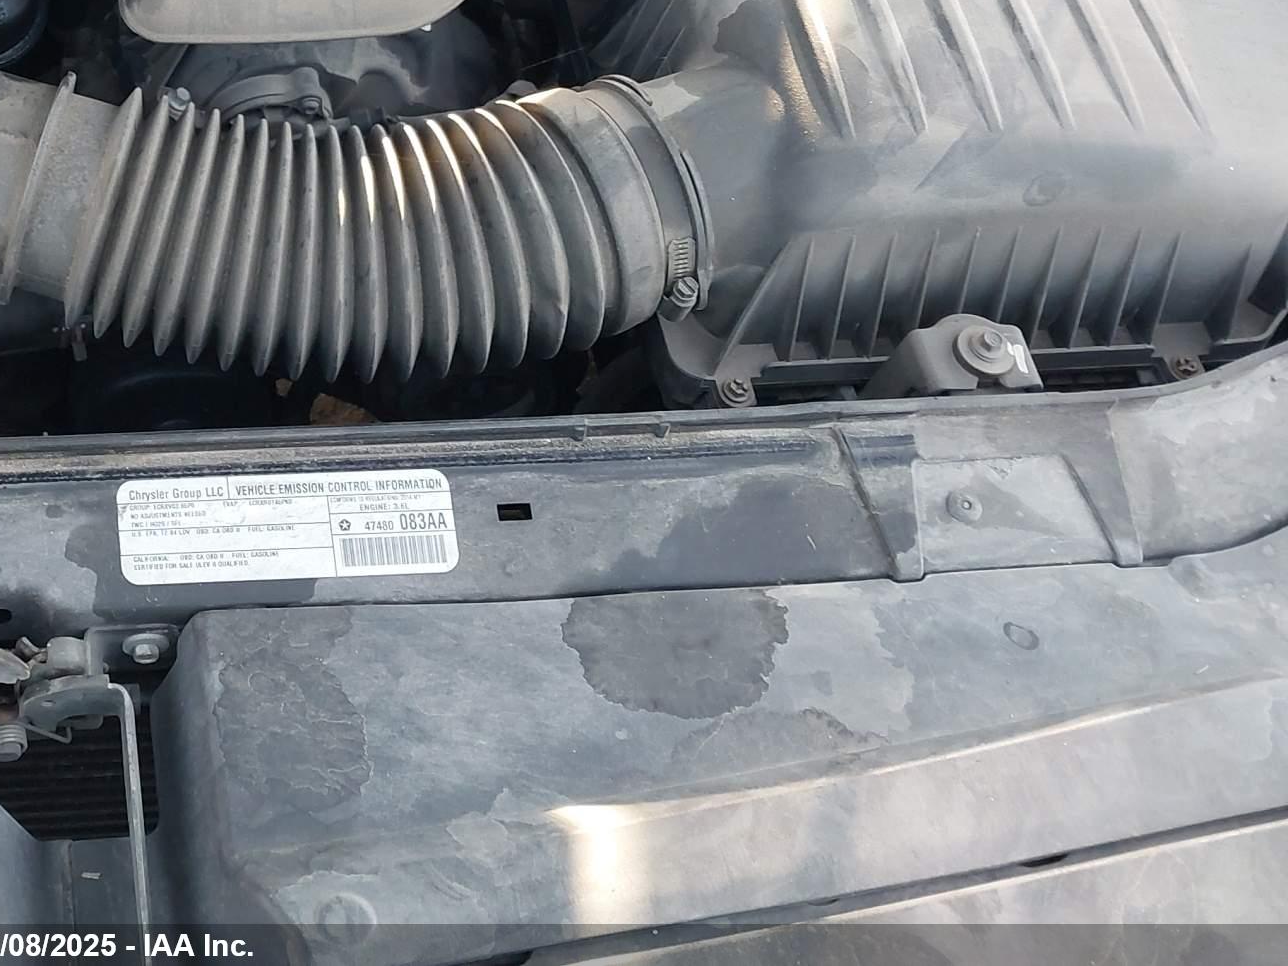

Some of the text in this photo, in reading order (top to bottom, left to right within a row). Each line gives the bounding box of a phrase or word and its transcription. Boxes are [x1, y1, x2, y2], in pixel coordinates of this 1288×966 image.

[128, 485, 225, 502] Chrysler Group LLC
[234, 478, 443, 496] VEHICLE EMISSION CONTROL INFORMATION
[364, 512, 448, 531] 47480 083AA
